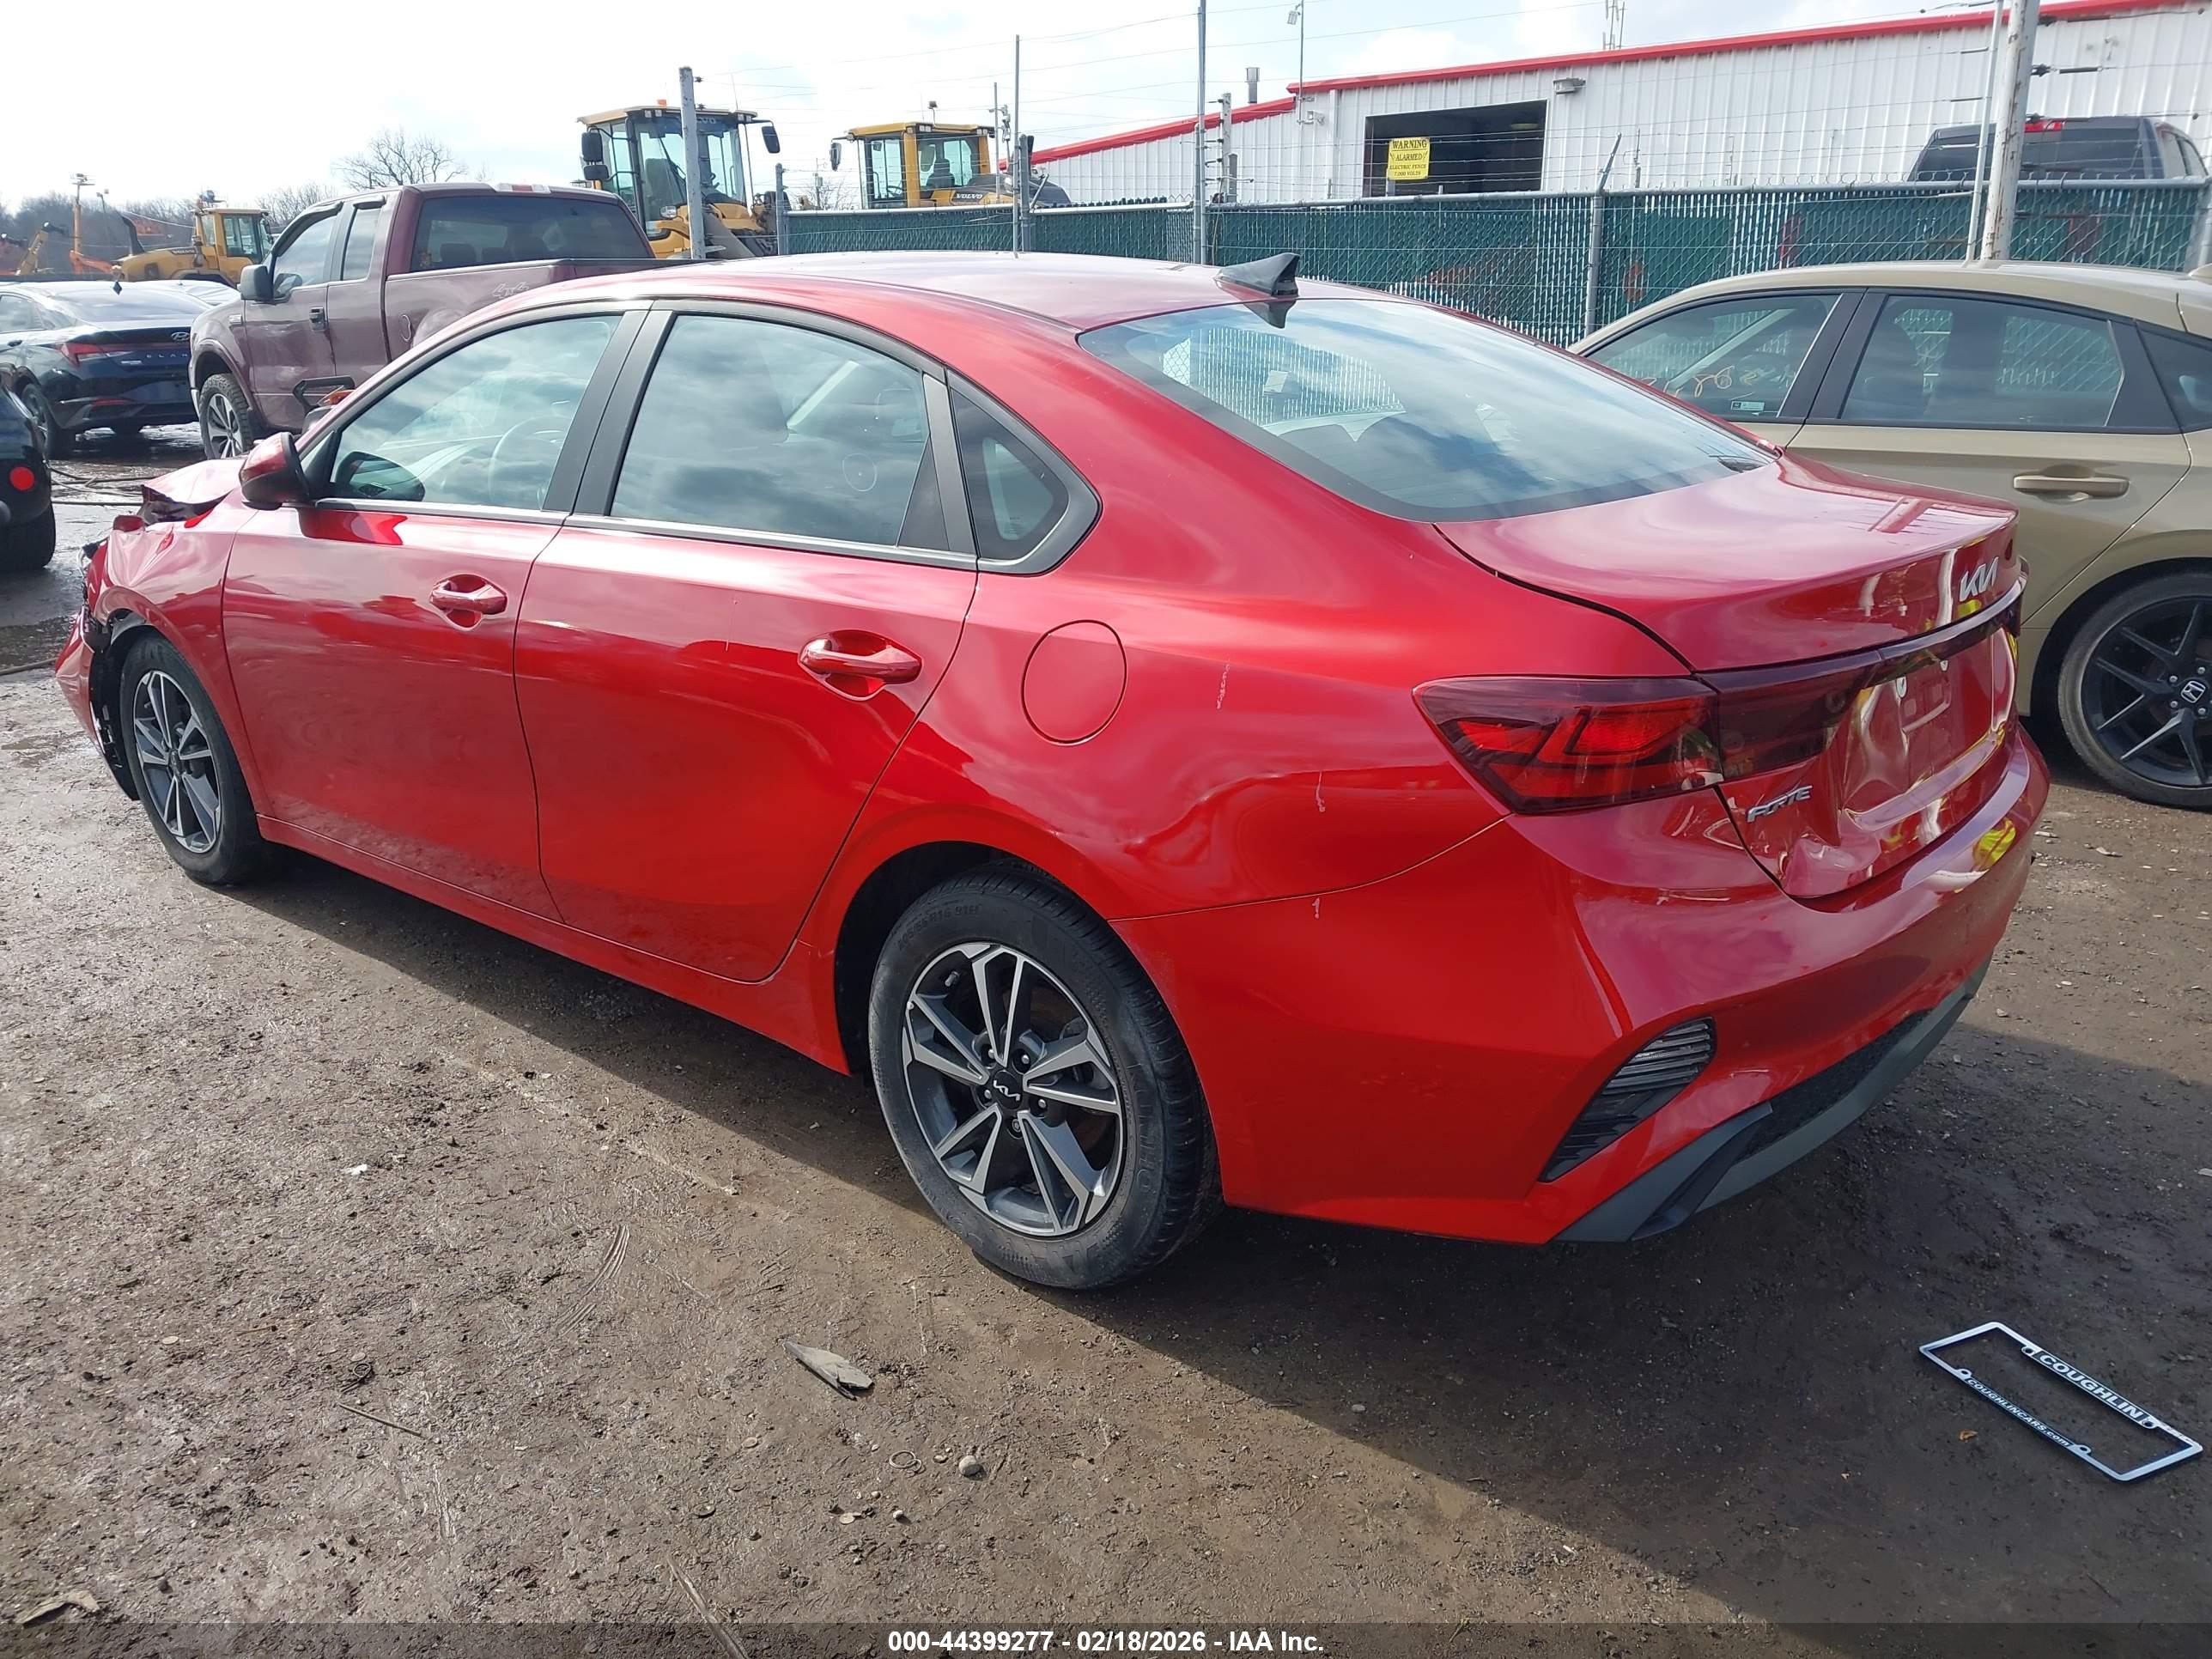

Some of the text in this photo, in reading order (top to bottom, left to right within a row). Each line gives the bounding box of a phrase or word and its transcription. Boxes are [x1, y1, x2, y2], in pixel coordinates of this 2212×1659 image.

[1392, 139, 1427, 149] WARNING
[1395, 153, 1423, 161] ALARMED
[1747, 785, 1813, 823] FORTE
[2039, 1354, 2144, 1419] COUGHLIN
[1967, 1379, 2070, 1447] COUGHLINCARS.com
